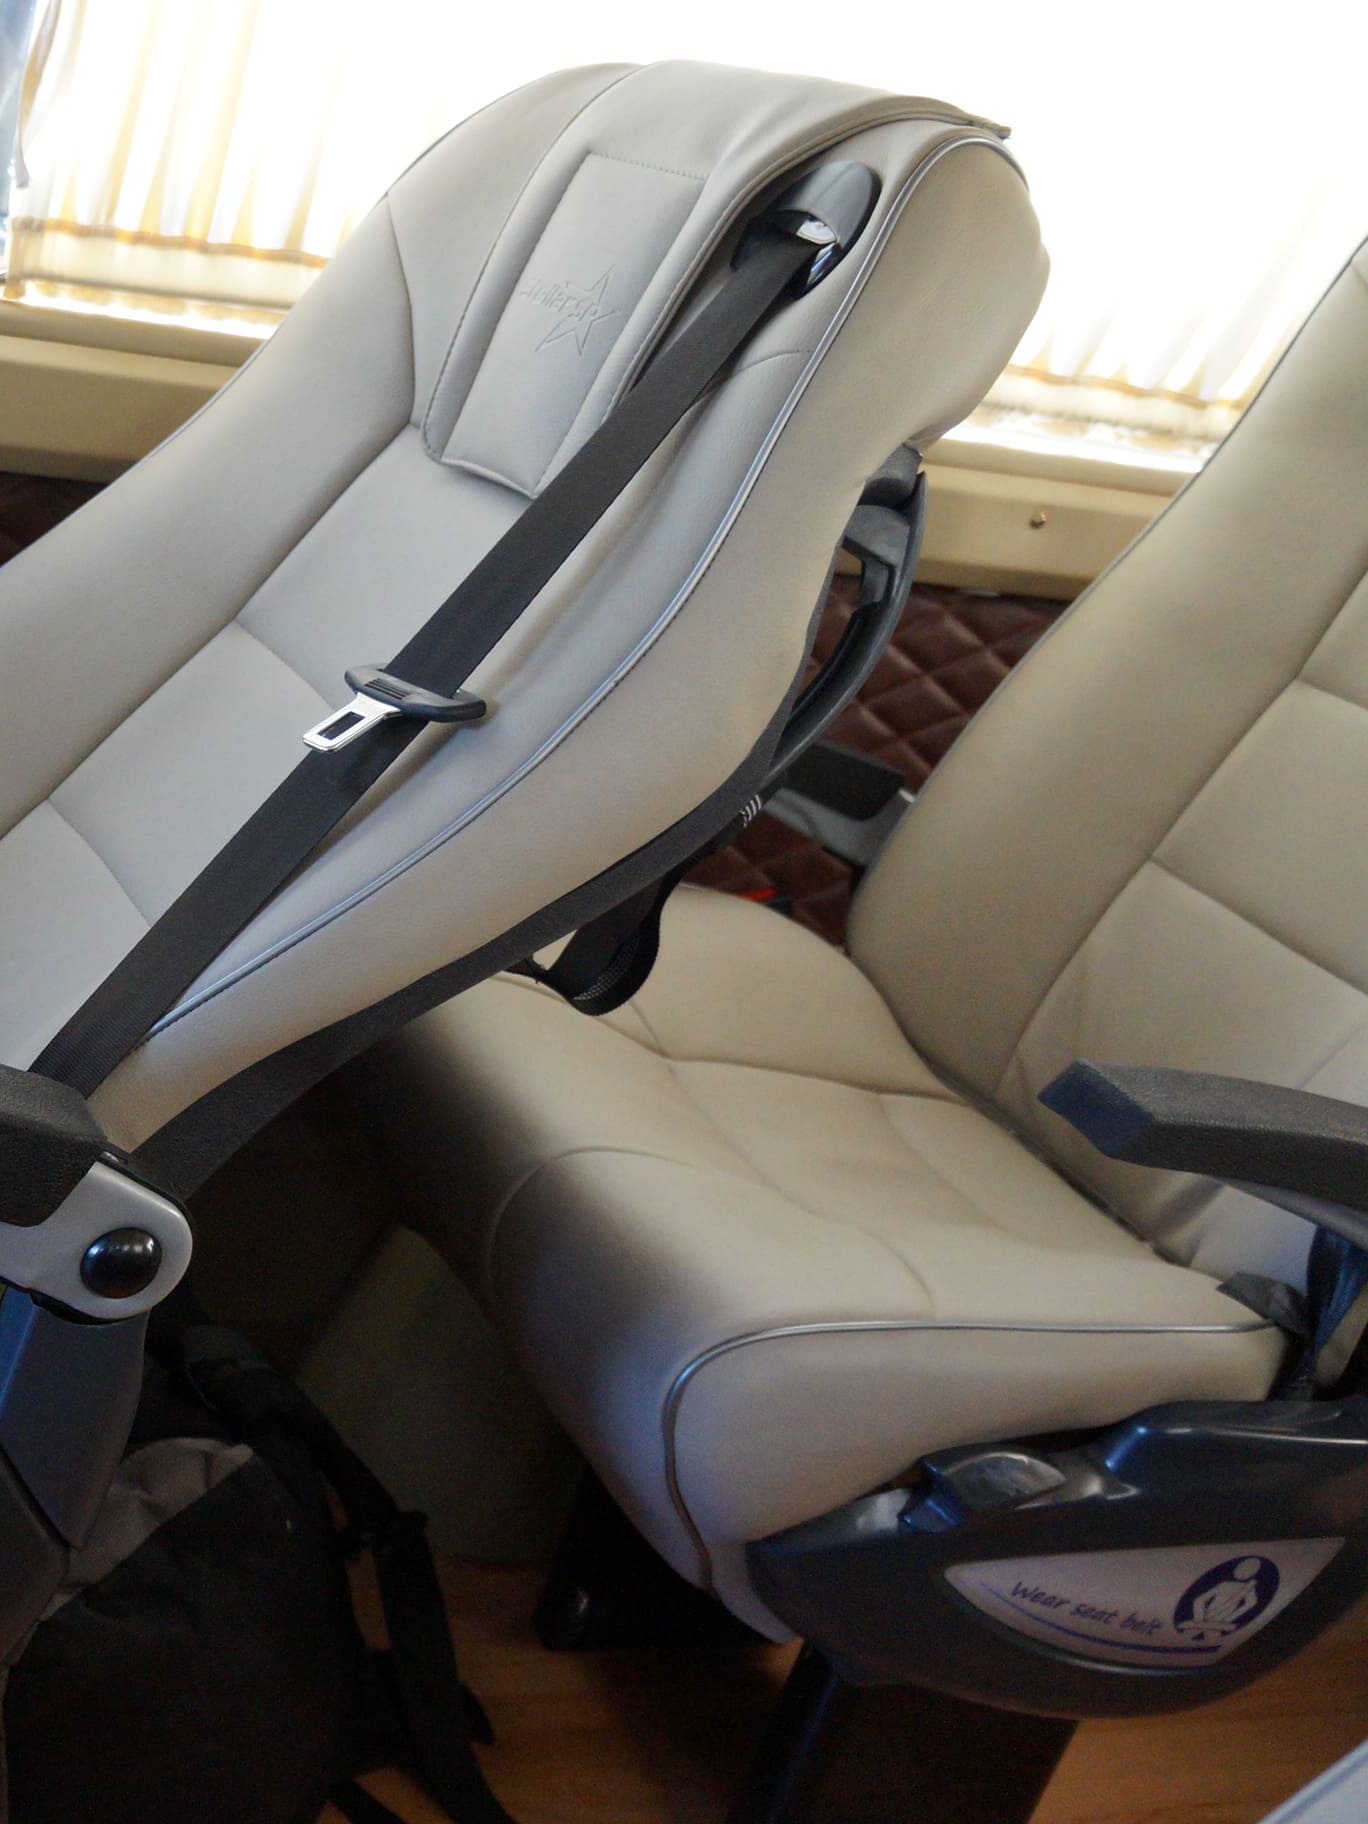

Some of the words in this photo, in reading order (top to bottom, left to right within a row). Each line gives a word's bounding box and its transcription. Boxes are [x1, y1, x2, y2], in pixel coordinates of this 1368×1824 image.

[1011, 1582, 1070, 1609] Wear
[1070, 1603, 1118, 1623] seat
[1121, 1612, 1163, 1634] belt
